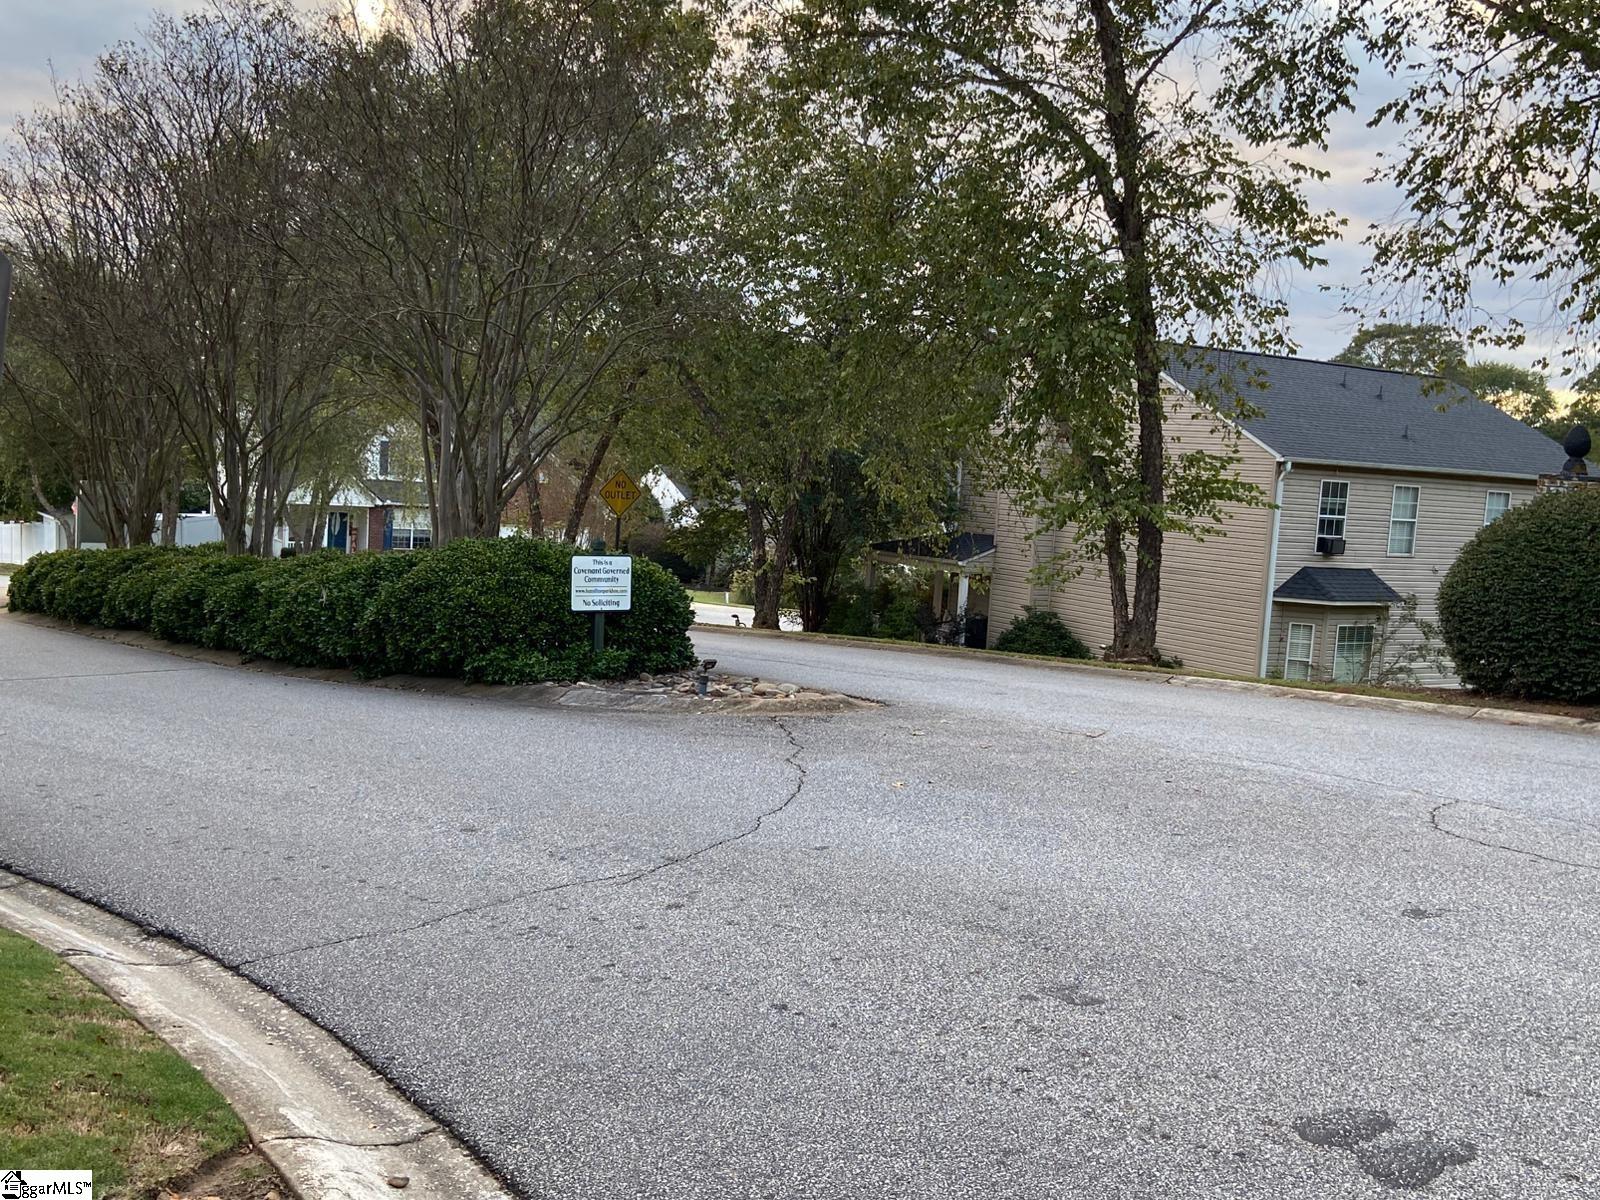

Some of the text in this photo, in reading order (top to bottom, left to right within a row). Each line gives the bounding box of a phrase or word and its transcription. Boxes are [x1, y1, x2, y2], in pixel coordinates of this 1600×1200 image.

[605, 491, 636, 499] OUTLET
[584, 576, 619, 584] Community
[592, 599, 620, 607] Soliciting
